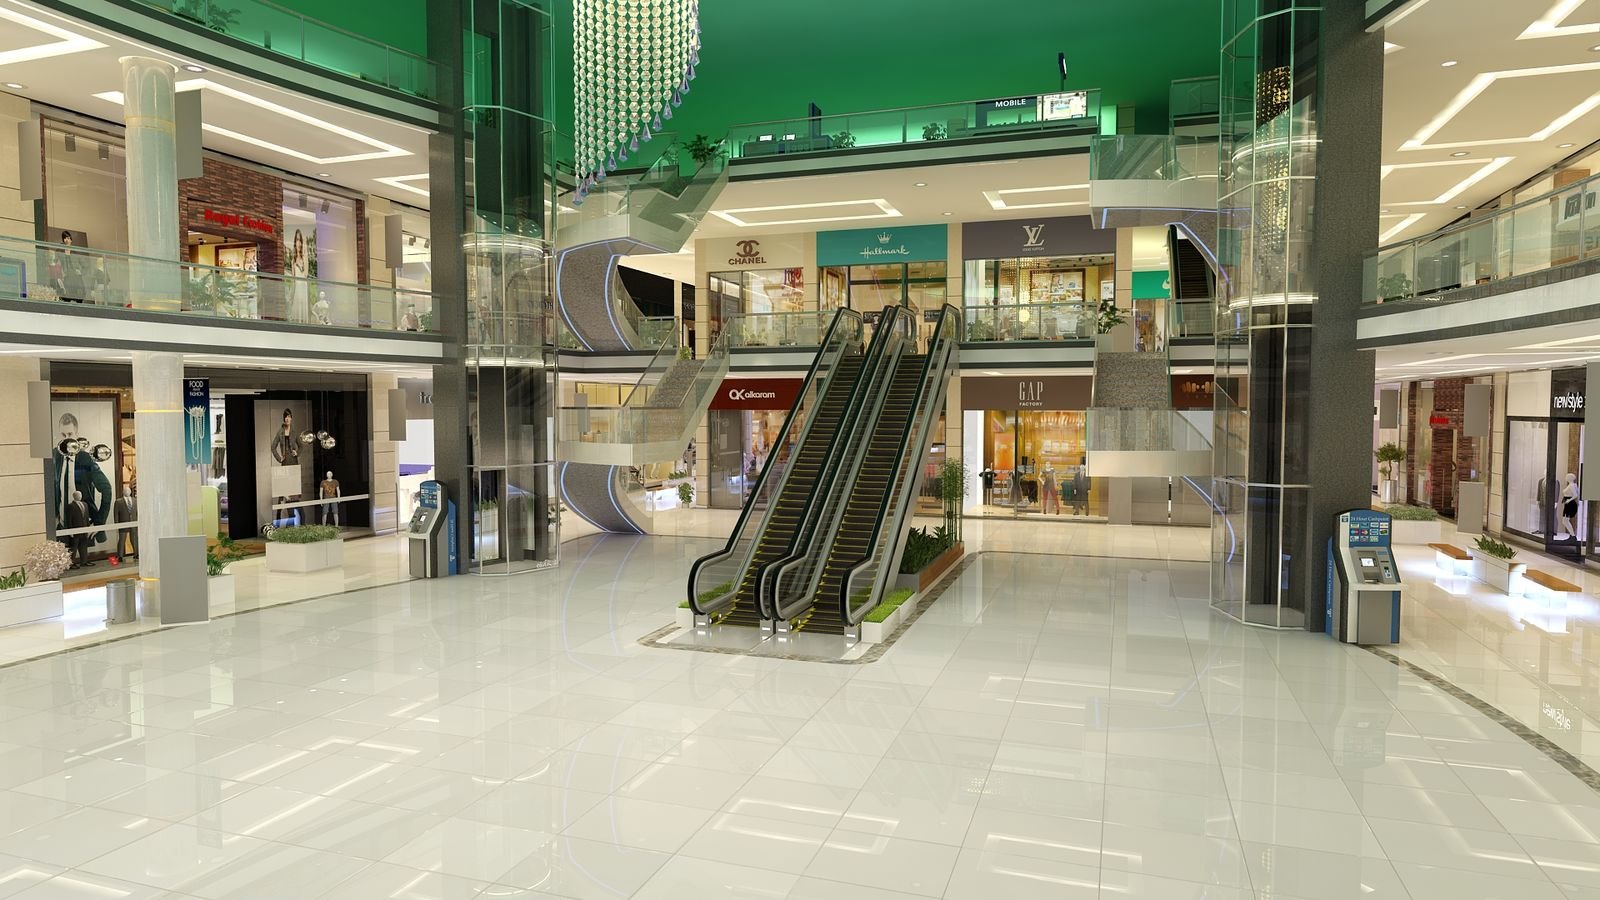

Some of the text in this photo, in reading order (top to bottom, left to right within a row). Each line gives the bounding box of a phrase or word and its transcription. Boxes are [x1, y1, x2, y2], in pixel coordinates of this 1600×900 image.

[995, 98, 1027, 108] MOBILE
[204, 208, 240, 228] Royal
[859, 245, 911, 260] Hallmark
[728, 256, 767, 266] CHANEL
[188, 380, 204, 388] FOOD
[745, 390, 776, 399] alkaram
[1019, 381, 1044, 401] GAP
